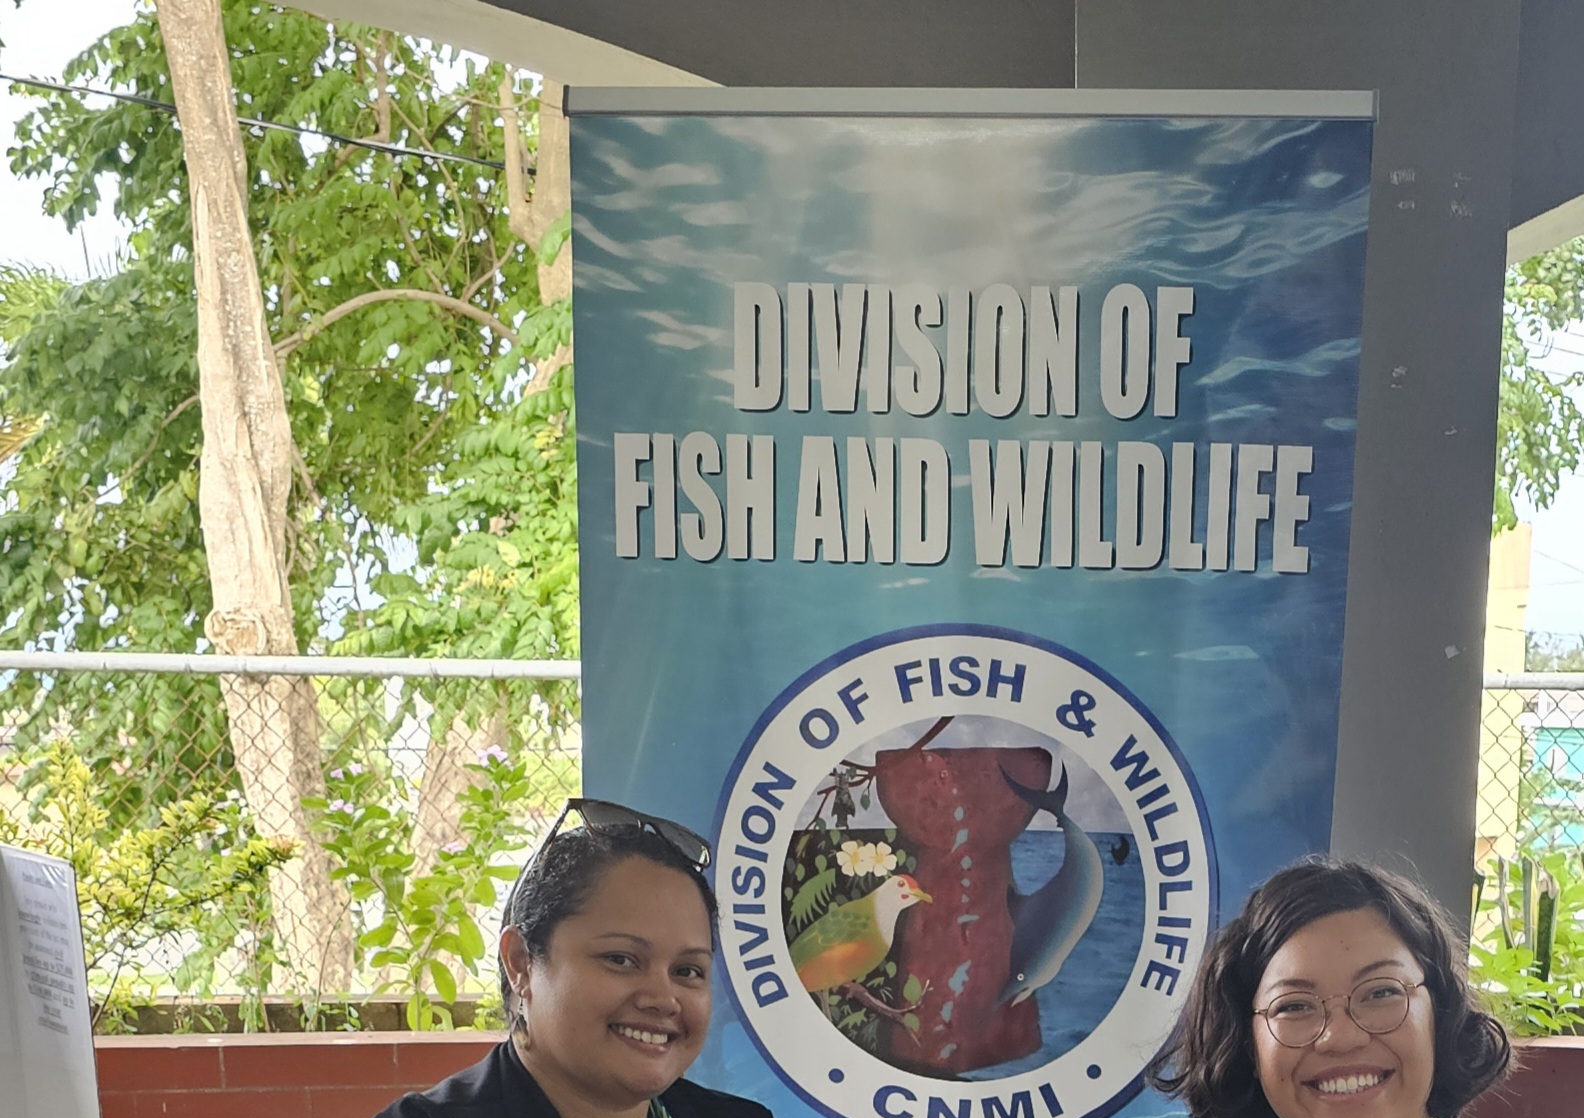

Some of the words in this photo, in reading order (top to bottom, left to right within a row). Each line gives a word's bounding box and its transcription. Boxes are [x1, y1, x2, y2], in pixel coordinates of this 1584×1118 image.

[733, 282, 1079, 417] DIVISION
[1100, 283, 1196, 419] OF
[614, 431, 776, 561] FISH
[799, 436, 952, 566] AND
[968, 439, 1314, 574] WILDLIFE
[732, 761, 798, 1009] DIVISION
[799, 678, 870, 750] OF
[894, 655, 1027, 704] FISH
[1055, 688, 1098, 738] &
[1108, 734, 1192, 998] WILDLIFE
